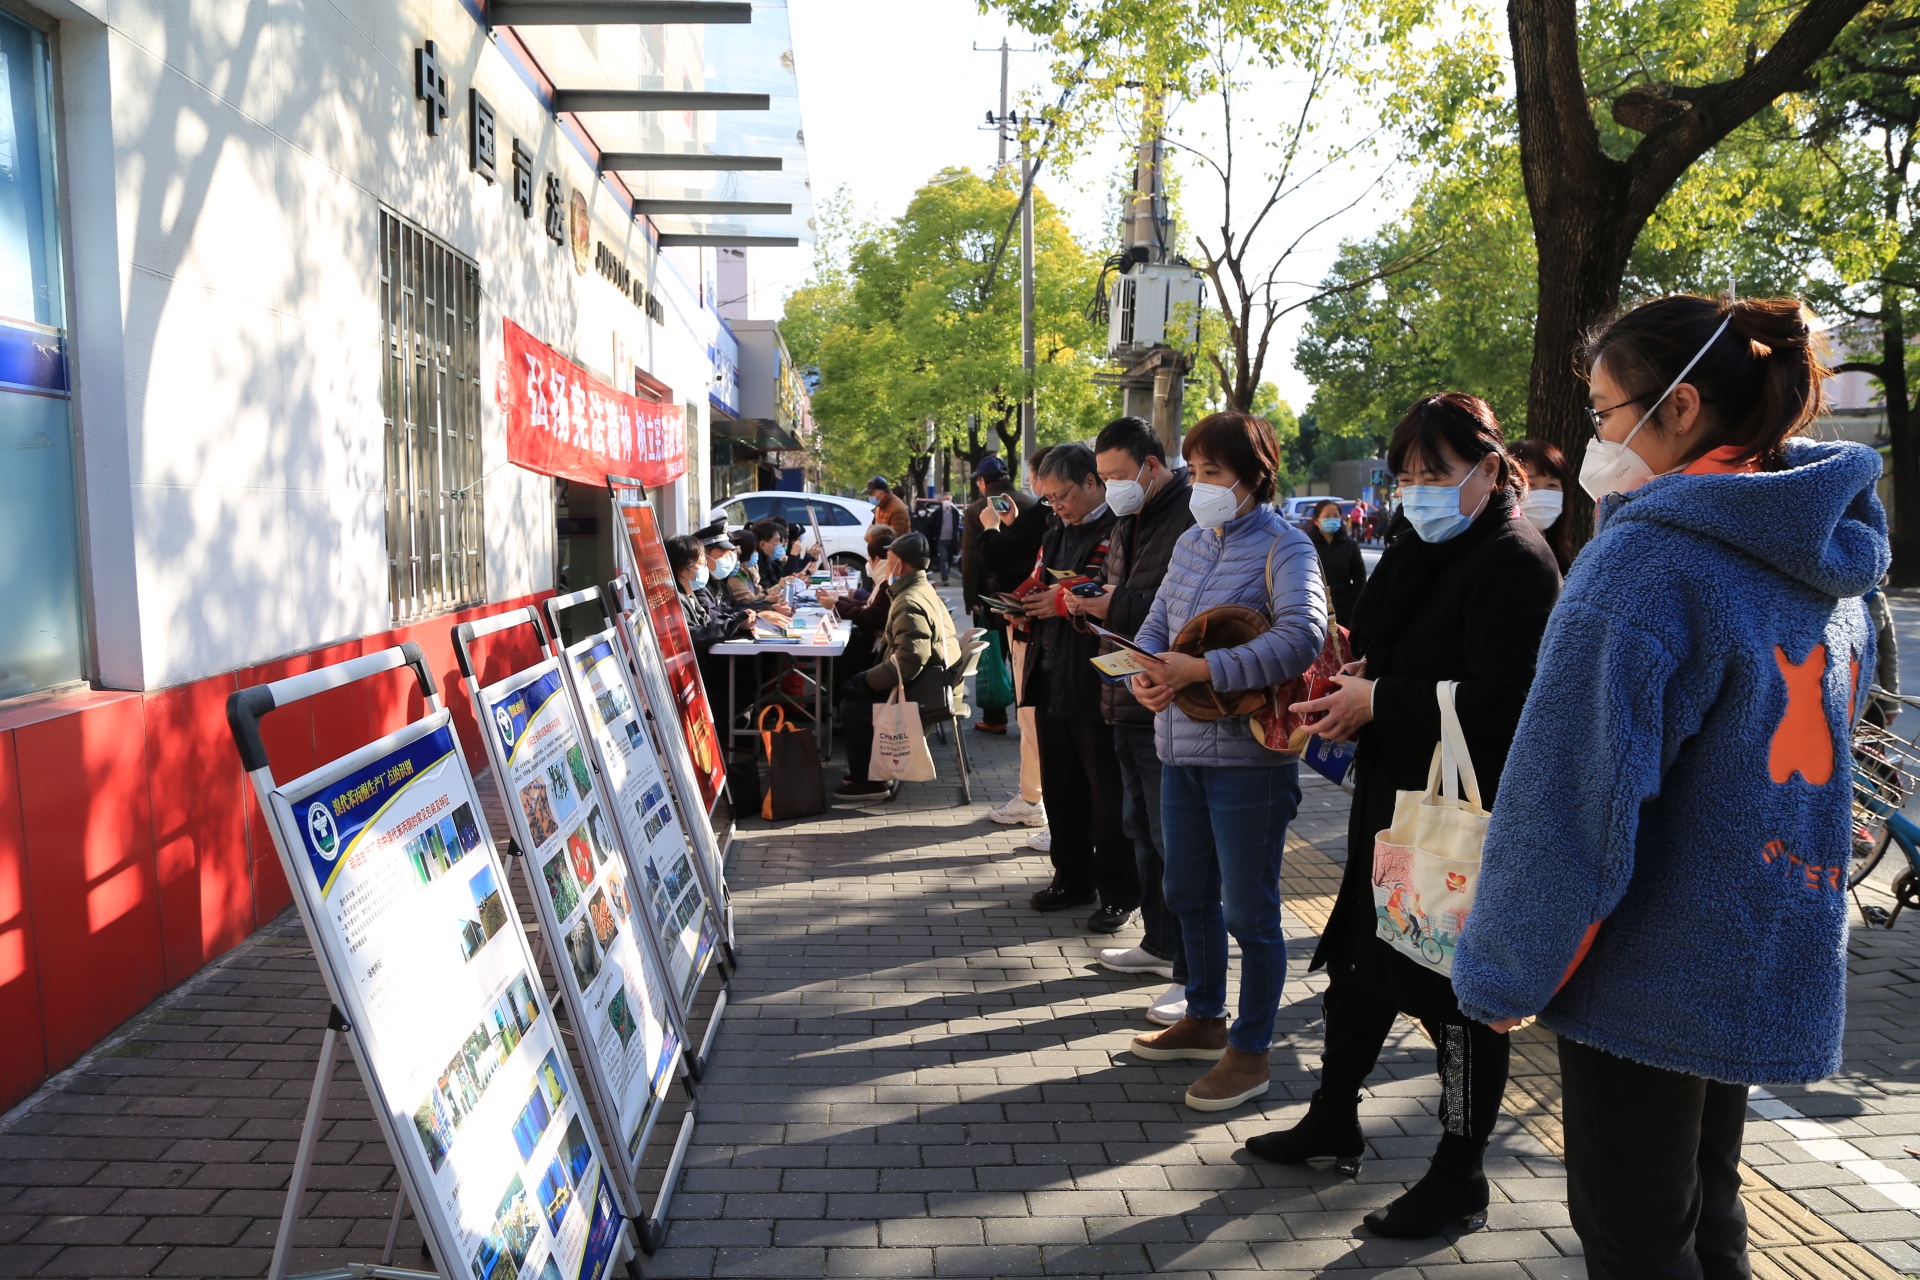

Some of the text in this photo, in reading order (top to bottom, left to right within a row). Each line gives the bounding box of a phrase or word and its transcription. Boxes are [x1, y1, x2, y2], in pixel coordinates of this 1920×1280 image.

[415, 40, 565, 246] 中国司法
[595, 241, 631, 297] JUSTICE
[633, 279, 643, 309] OF
[525, 352, 633, 462] 弘扬宪法精神
[879, 733, 908, 741] CHANEL
